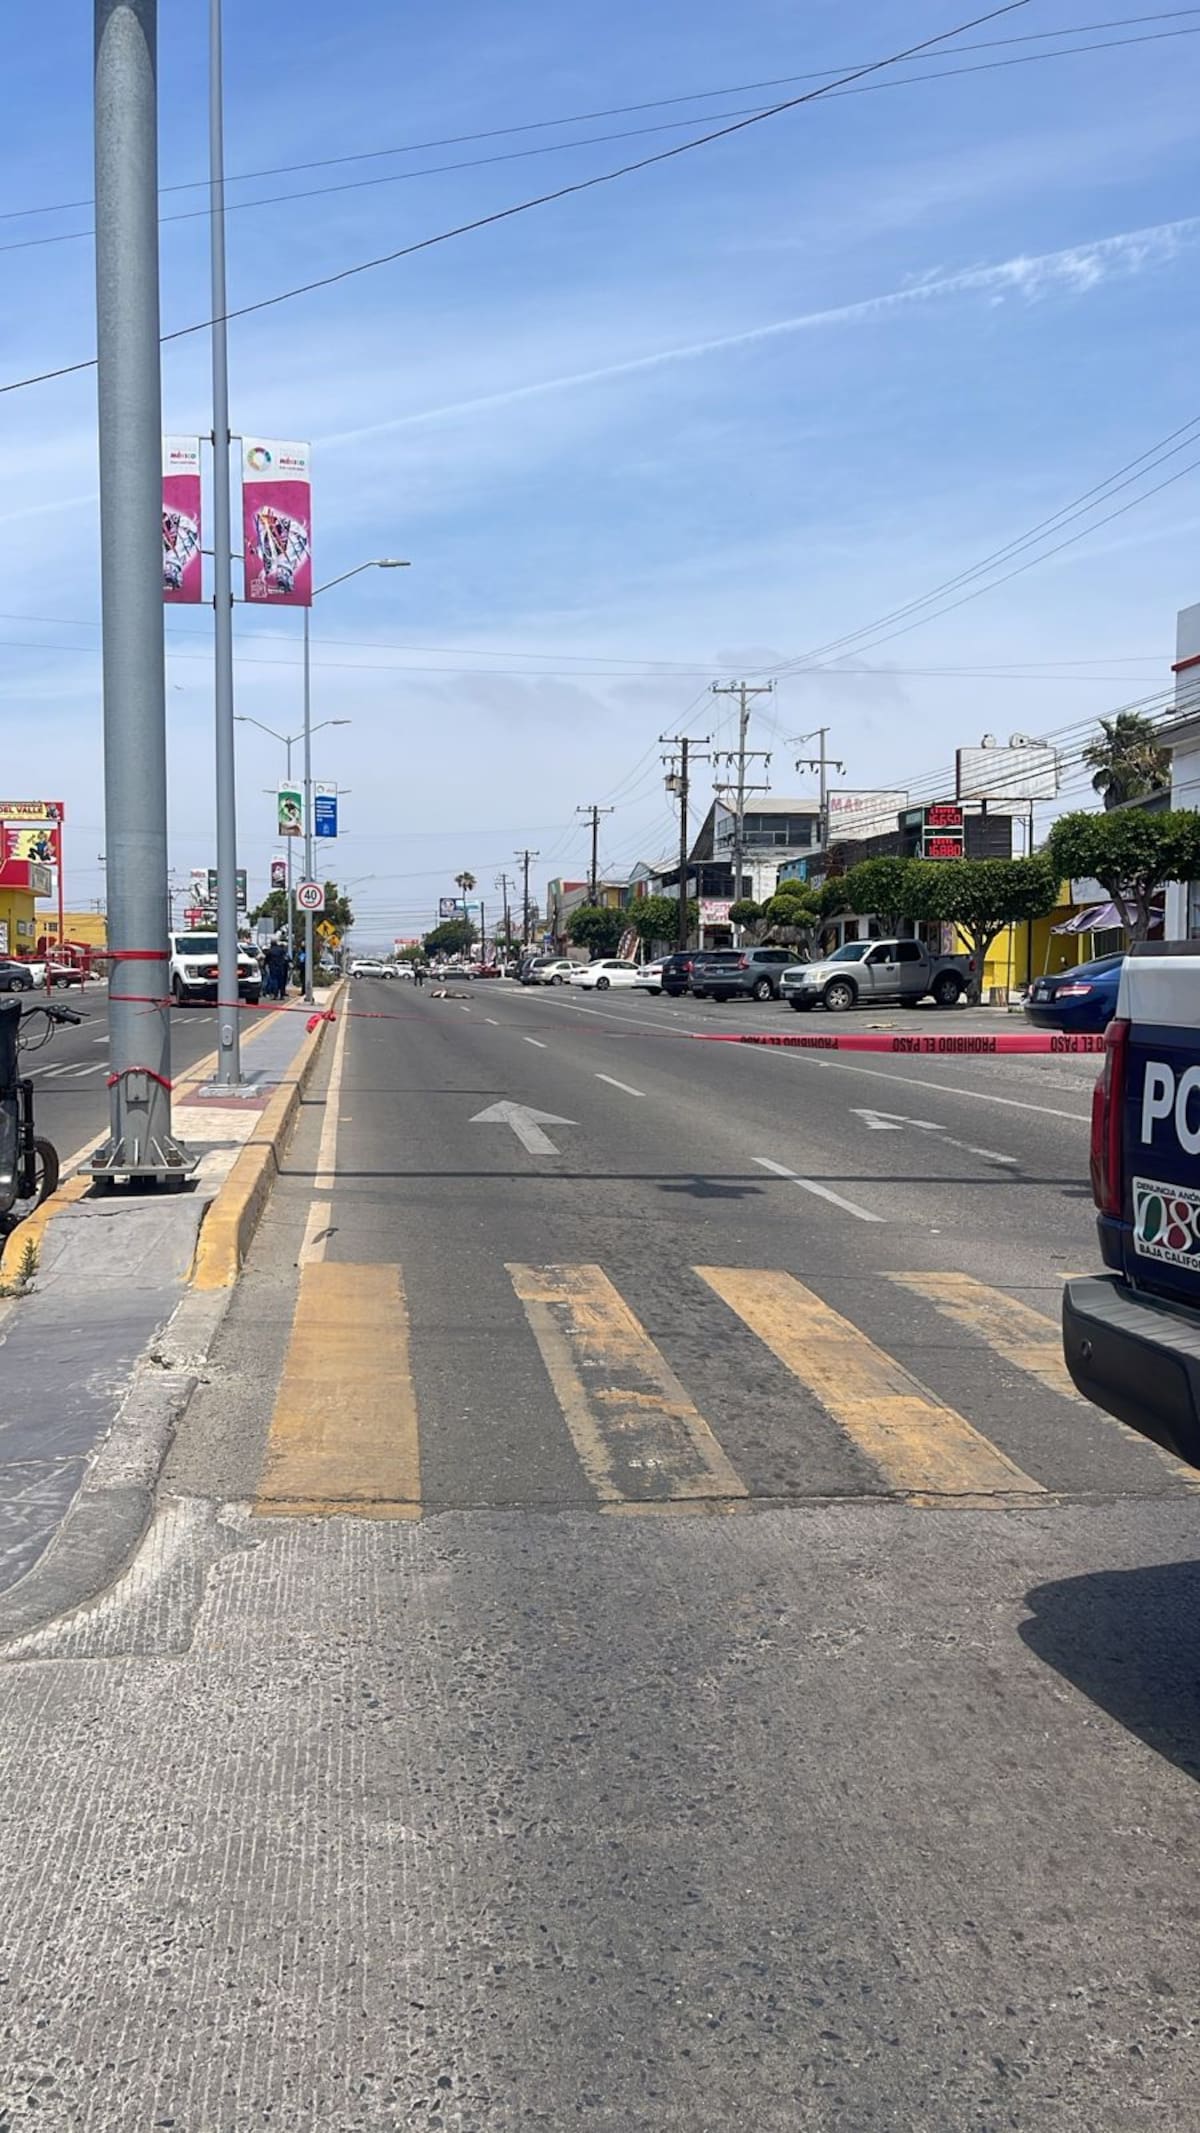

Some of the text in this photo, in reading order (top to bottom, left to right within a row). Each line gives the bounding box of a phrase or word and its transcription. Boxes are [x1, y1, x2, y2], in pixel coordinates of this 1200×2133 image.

[304, 889, 317, 900] 40
[784, 1037, 839, 1050] PROHIBIDO
[892, 1037, 996, 1052] PROHIBIDO EL PASO
[1050, 1036, 1079, 1052] PASO
[1080, 1036, 1093, 1052] EL
[1136, 1181, 1176, 1197] DENUNCIA
[1139, 1243, 1163, 1258] BAJA
